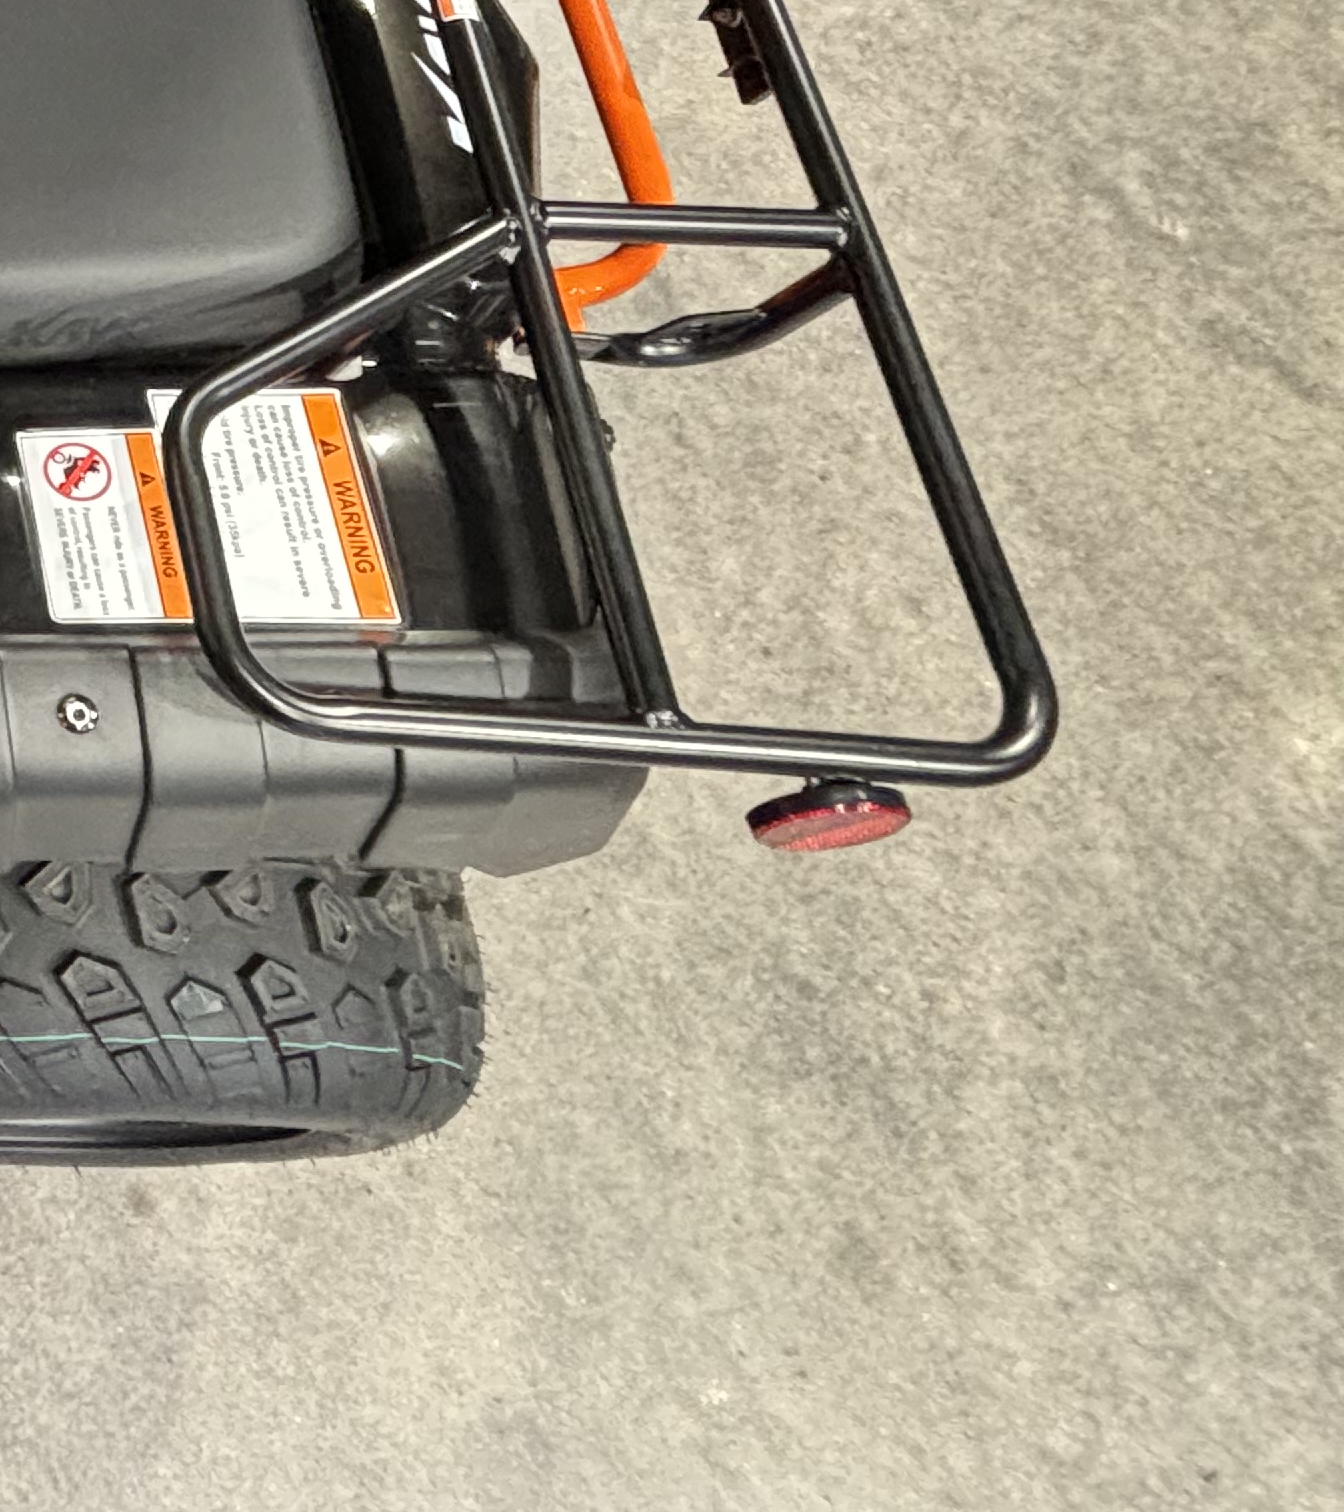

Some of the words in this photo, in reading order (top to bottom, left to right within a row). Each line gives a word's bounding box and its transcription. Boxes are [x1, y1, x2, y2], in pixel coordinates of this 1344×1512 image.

[239, 405, 255, 436] injury
[267, 404, 280, 424] can
[280, 404, 301, 452] Improper
[272, 426, 289, 459] cause
[294, 454, 306, 474] tire
[253, 404, 268, 431] Loss
[264, 446, 284, 486] control
[274, 487, 287, 508] can
[281, 510, 298, 543] result
[282, 460, 295, 484] loss
[297, 476, 320, 525] pressure
[149, 505, 178, 579] WARNING
[332, 480, 376, 574] WARNING
[317, 542, 343, 611] overloading
